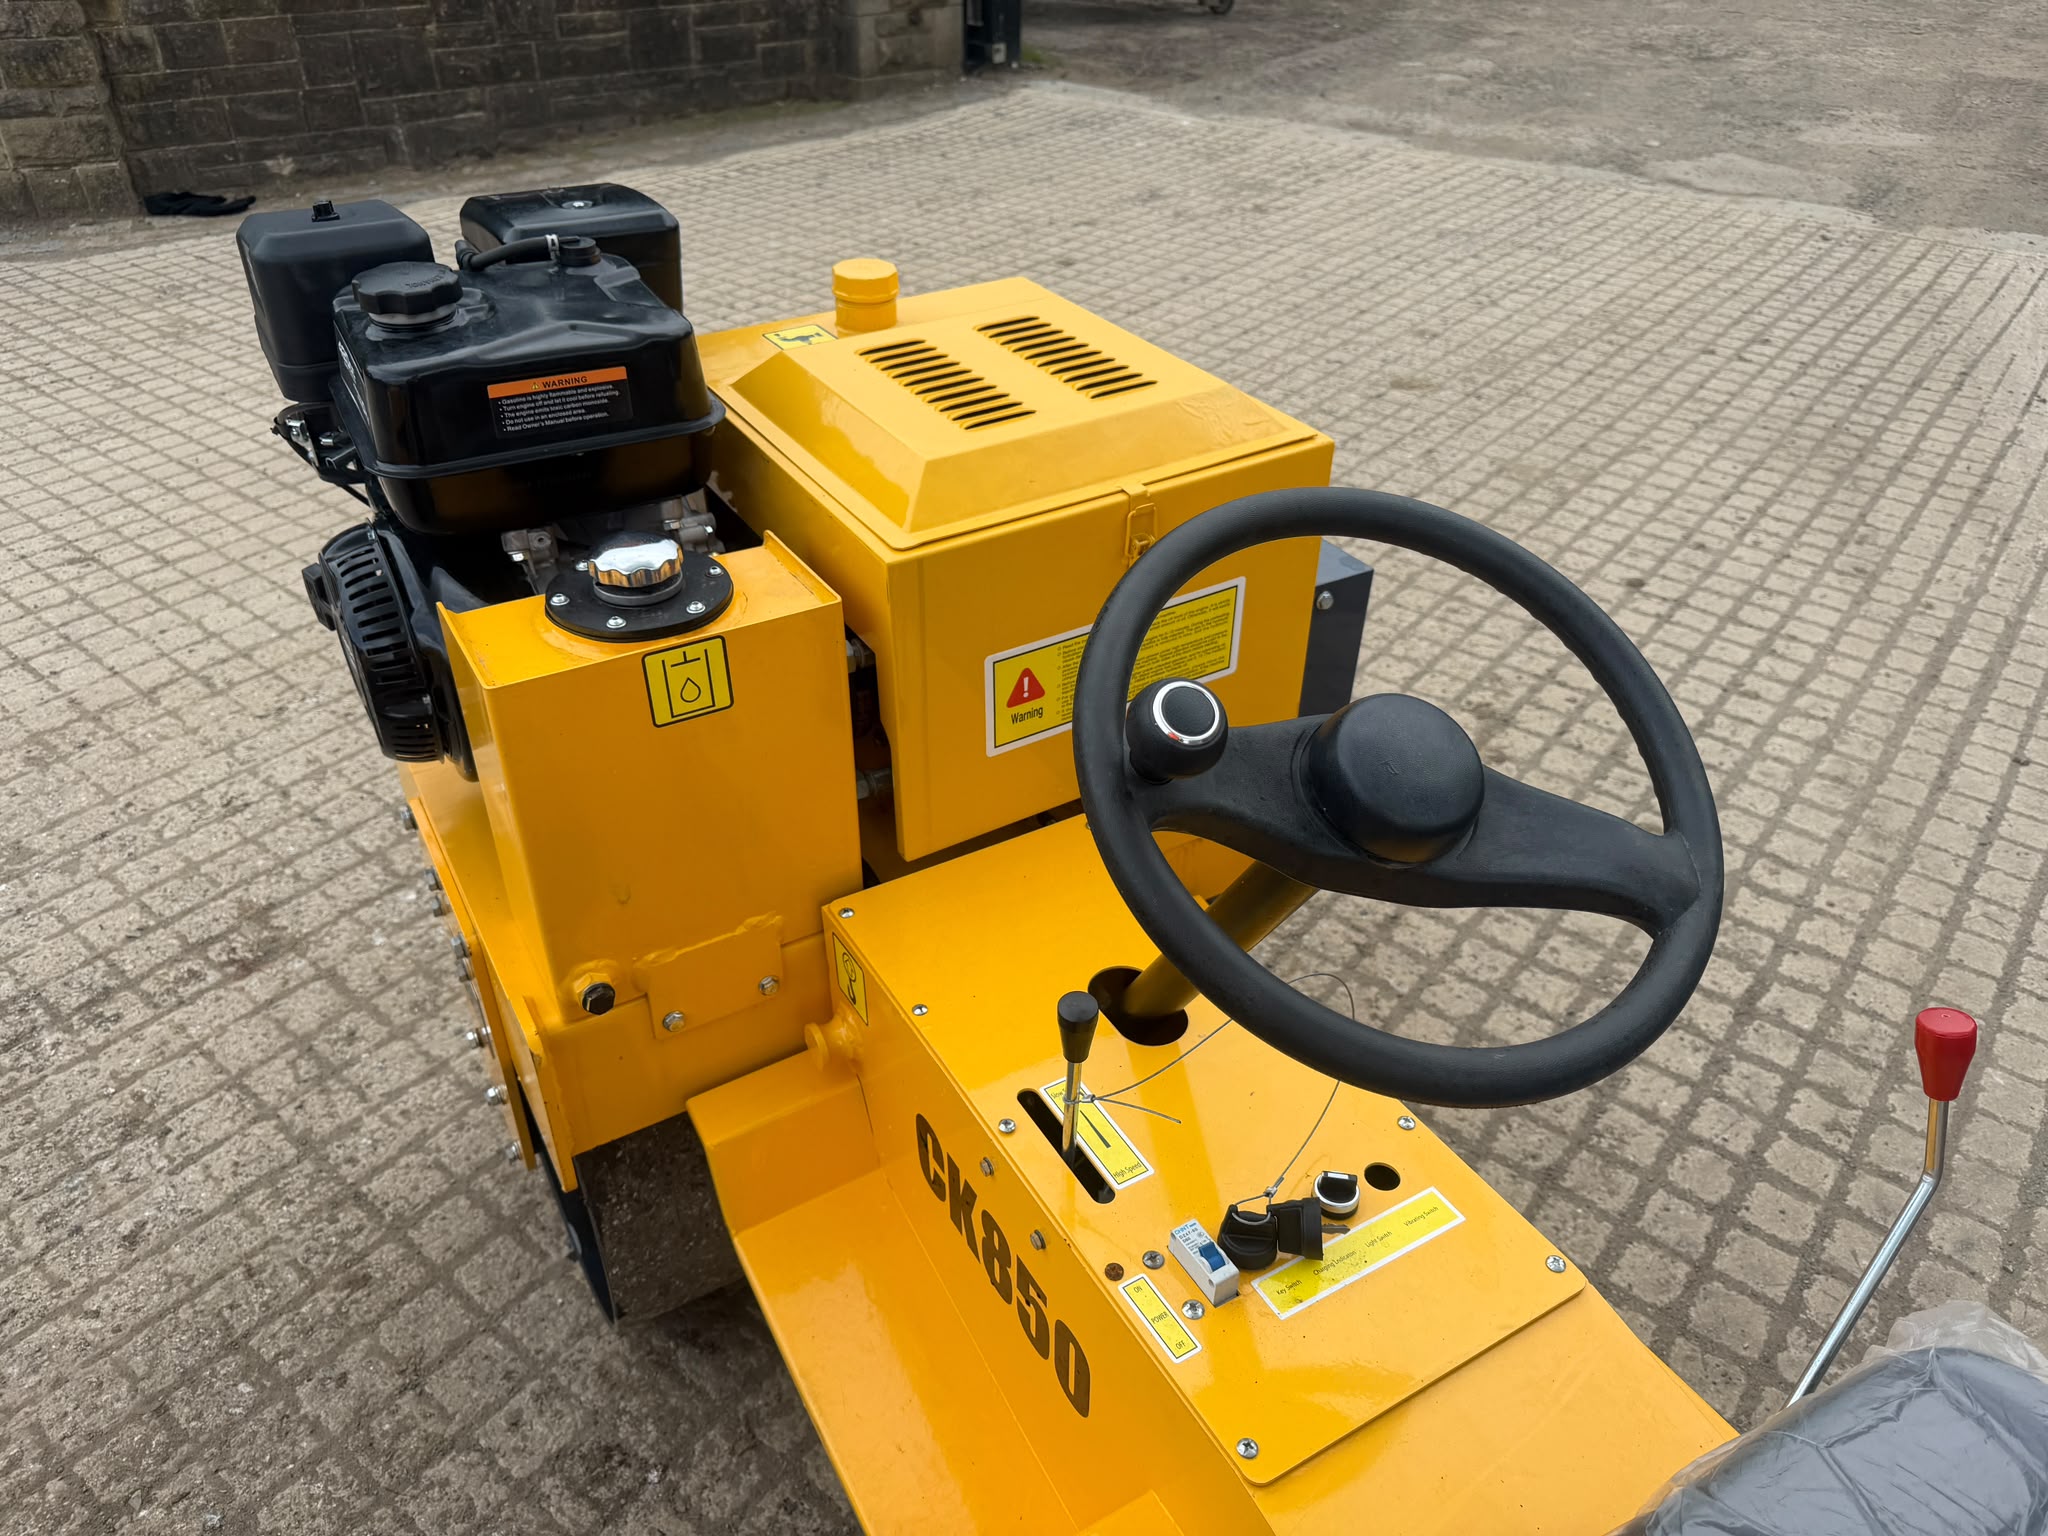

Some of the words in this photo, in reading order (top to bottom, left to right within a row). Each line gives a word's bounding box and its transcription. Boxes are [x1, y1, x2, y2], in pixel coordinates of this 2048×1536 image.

[542, 376, 588, 388] WARNING
[502, 397, 526, 405] Gasoline
[548, 410, 572, 418] enclosed
[583, 412, 610, 420] operation.
[1011, 706, 1044, 725] Warning
[1112, 1167, 1126, 1179] High
[1124, 1161, 1142, 1175] Speed
[1403, 1213, 1426, 1227] Vibrating
[1423, 1206, 1439, 1217] Switch
[1364, 1237, 1378, 1248] Light
[1376, 1230, 1393, 1242] Switch
[916, 1112, 1091, 1418] CK850
[1313, 1260, 1336, 1276] Charging
[1133, 1285, 1143, 1294] ON
[1276, 1287, 1287, 1296] Key
[1285, 1279, 1303, 1291] Switch
[1150, 1311, 1169, 1325] POWER
[1175, 1340, 1186, 1350] OFF
